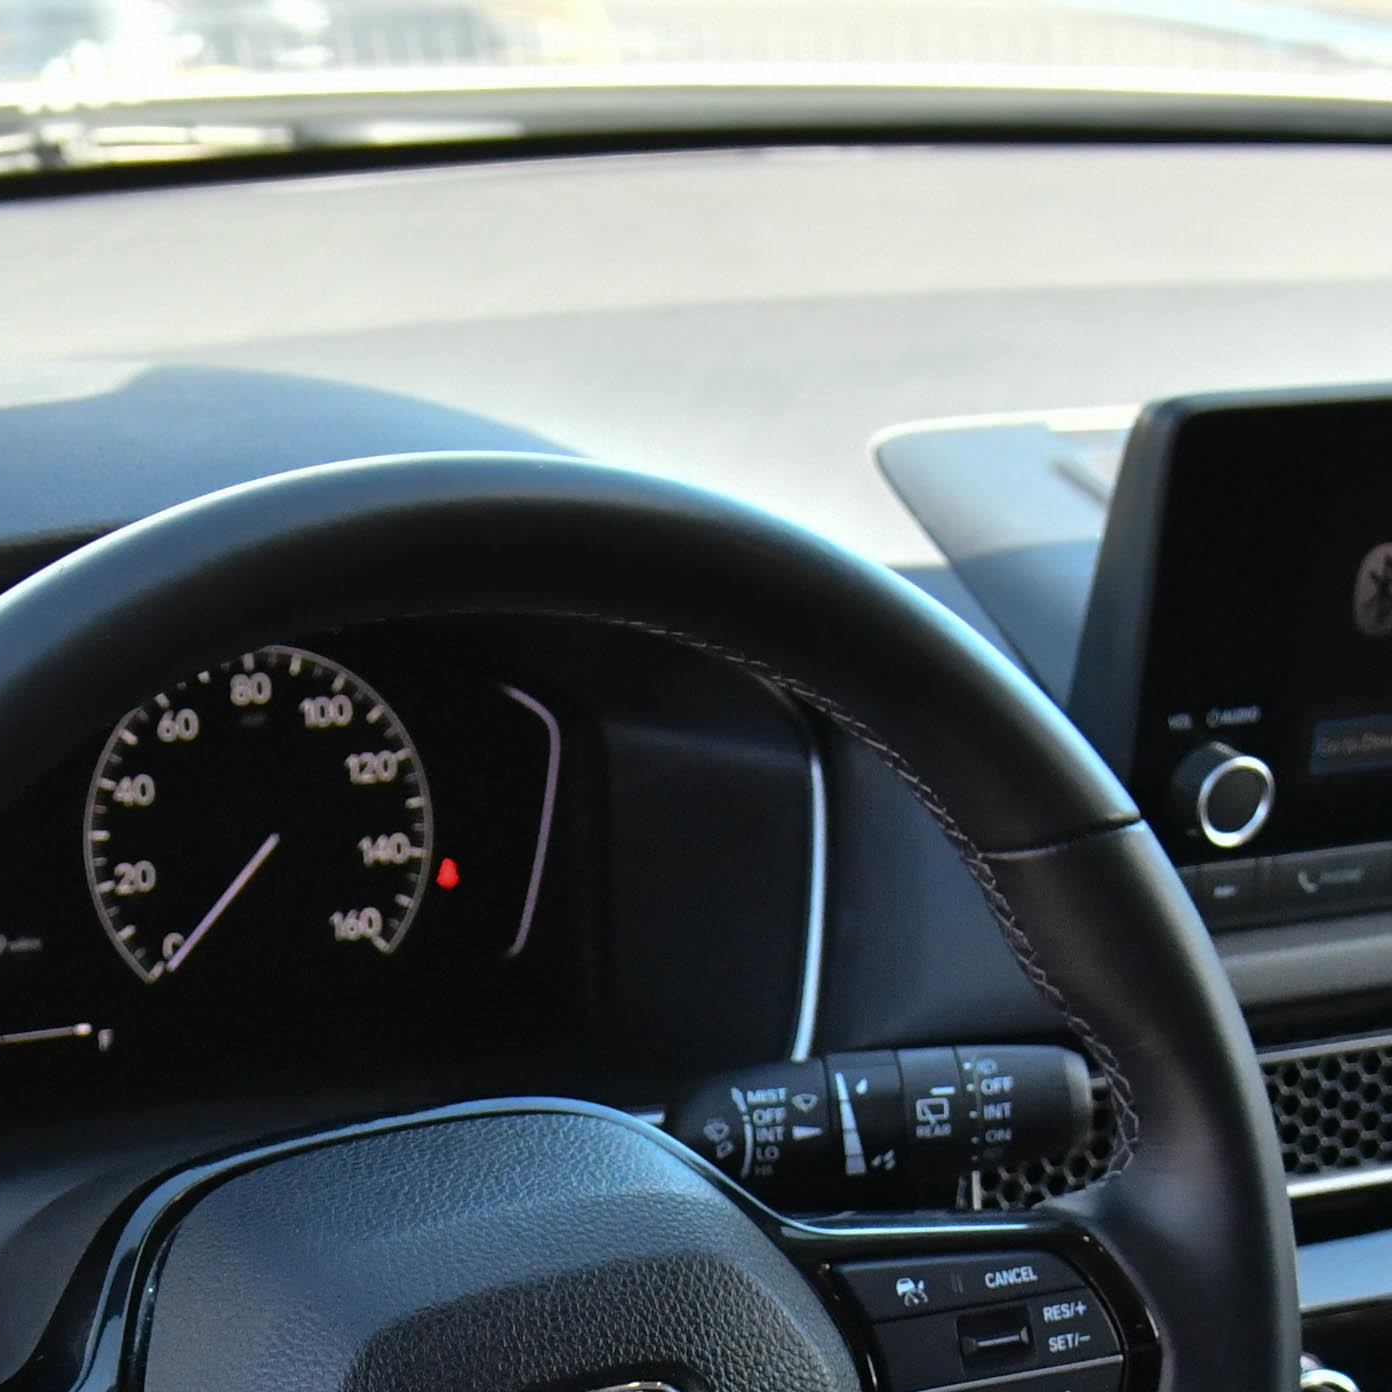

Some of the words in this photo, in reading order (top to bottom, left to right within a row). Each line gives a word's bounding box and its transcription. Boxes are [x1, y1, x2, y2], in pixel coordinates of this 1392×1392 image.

[230, 672, 273, 705] 80
[300, 694, 353, 728] 100
[157, 708, 200, 743] 60
[345, 750, 398, 784] 120
[114, 774, 156, 806] 40
[358, 832, 409, 866] 140
[114, 860, 156, 894] 20
[330, 906, 382, 942] 160
[746, 1087, 788, 1104] MIST
[981, 1075, 1014, 1095] OFF
[752, 1107, 787, 1125] OFF
[983, 1101, 1013, 1120] INT
[756, 1125, 785, 1143] INT
[915, 1122, 952, 1138] REAR
[985, 1128, 1013, 1143] ON
[756, 1145, 781, 1160] LO
[984, 1265, 1039, 1289] CANCEL
[1043, 1301, 1087, 1323] RES/+
